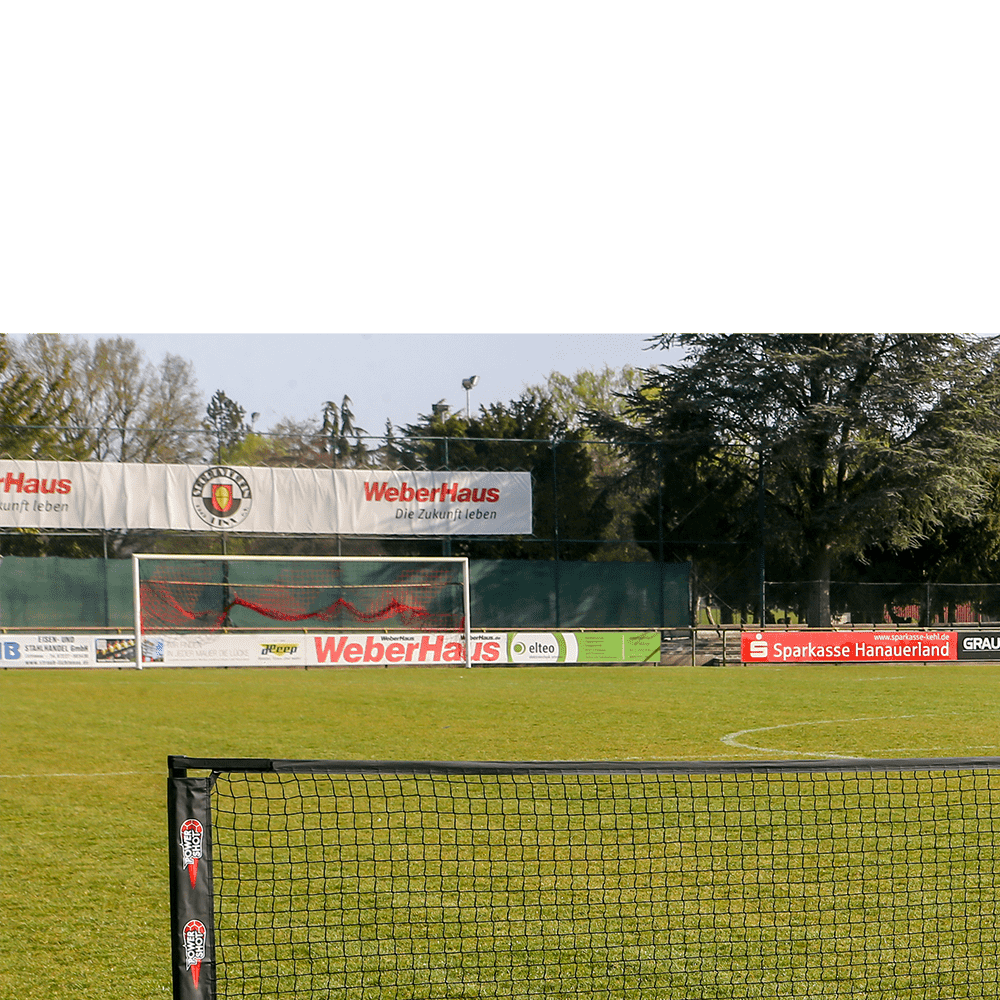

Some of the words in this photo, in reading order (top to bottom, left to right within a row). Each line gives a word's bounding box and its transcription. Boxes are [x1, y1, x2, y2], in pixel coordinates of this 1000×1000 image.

[364, 482, 500, 502] WeberHaus
[33, 499, 69, 512] leben
[395, 508, 414, 519] Die
[418, 508, 461, 521] Zukunft
[465, 508, 497, 520] leben
[314, 635, 501, 663] WeberHaus
[529, 642, 555, 653] elteo
[773, 643, 850, 660] Sparkasse
[855, 642, 950, 658] Hanauerland
[183, 830, 194, 864] POWER
[192, 830, 201, 858] SHOT
[187, 931, 197, 965] POWER
[195, 931, 204, 958] SHOT
